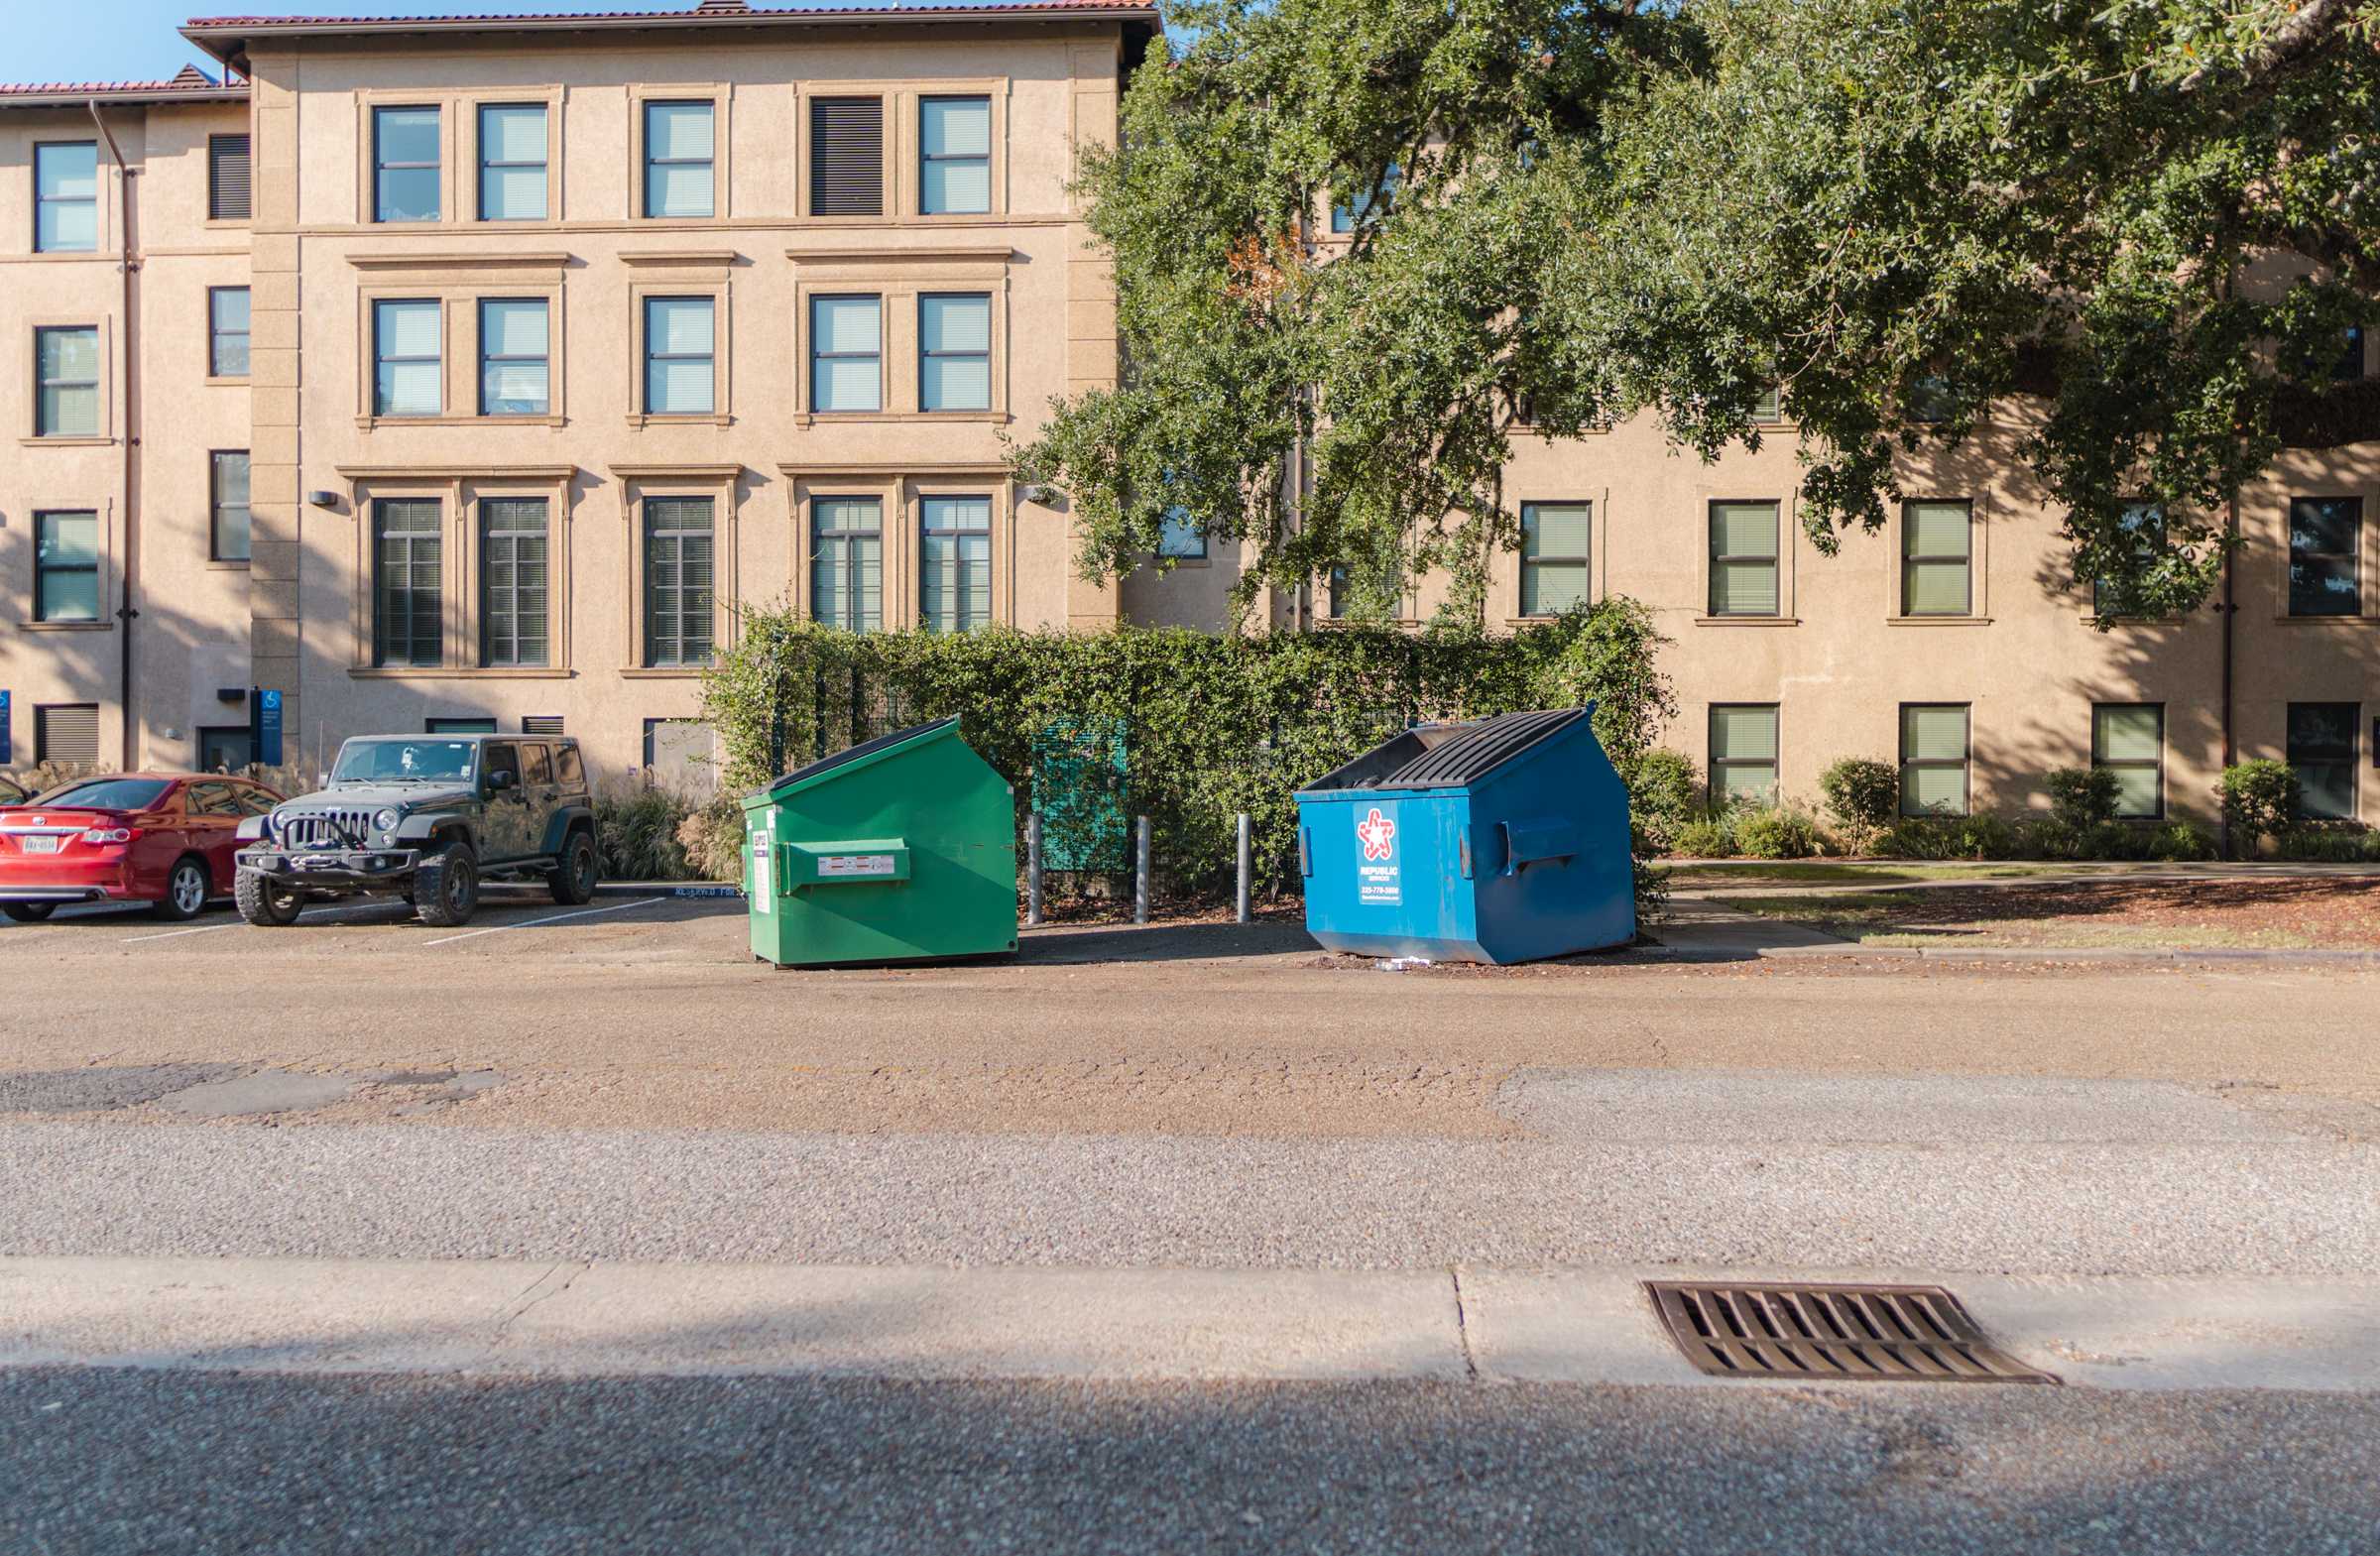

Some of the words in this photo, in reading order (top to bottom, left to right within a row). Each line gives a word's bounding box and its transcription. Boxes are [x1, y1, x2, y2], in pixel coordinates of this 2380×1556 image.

[1360, 866, 1398, 876] REPUBLIC
[674, 888, 716, 897] RESERVED
[720, 887, 735, 896] FOR
